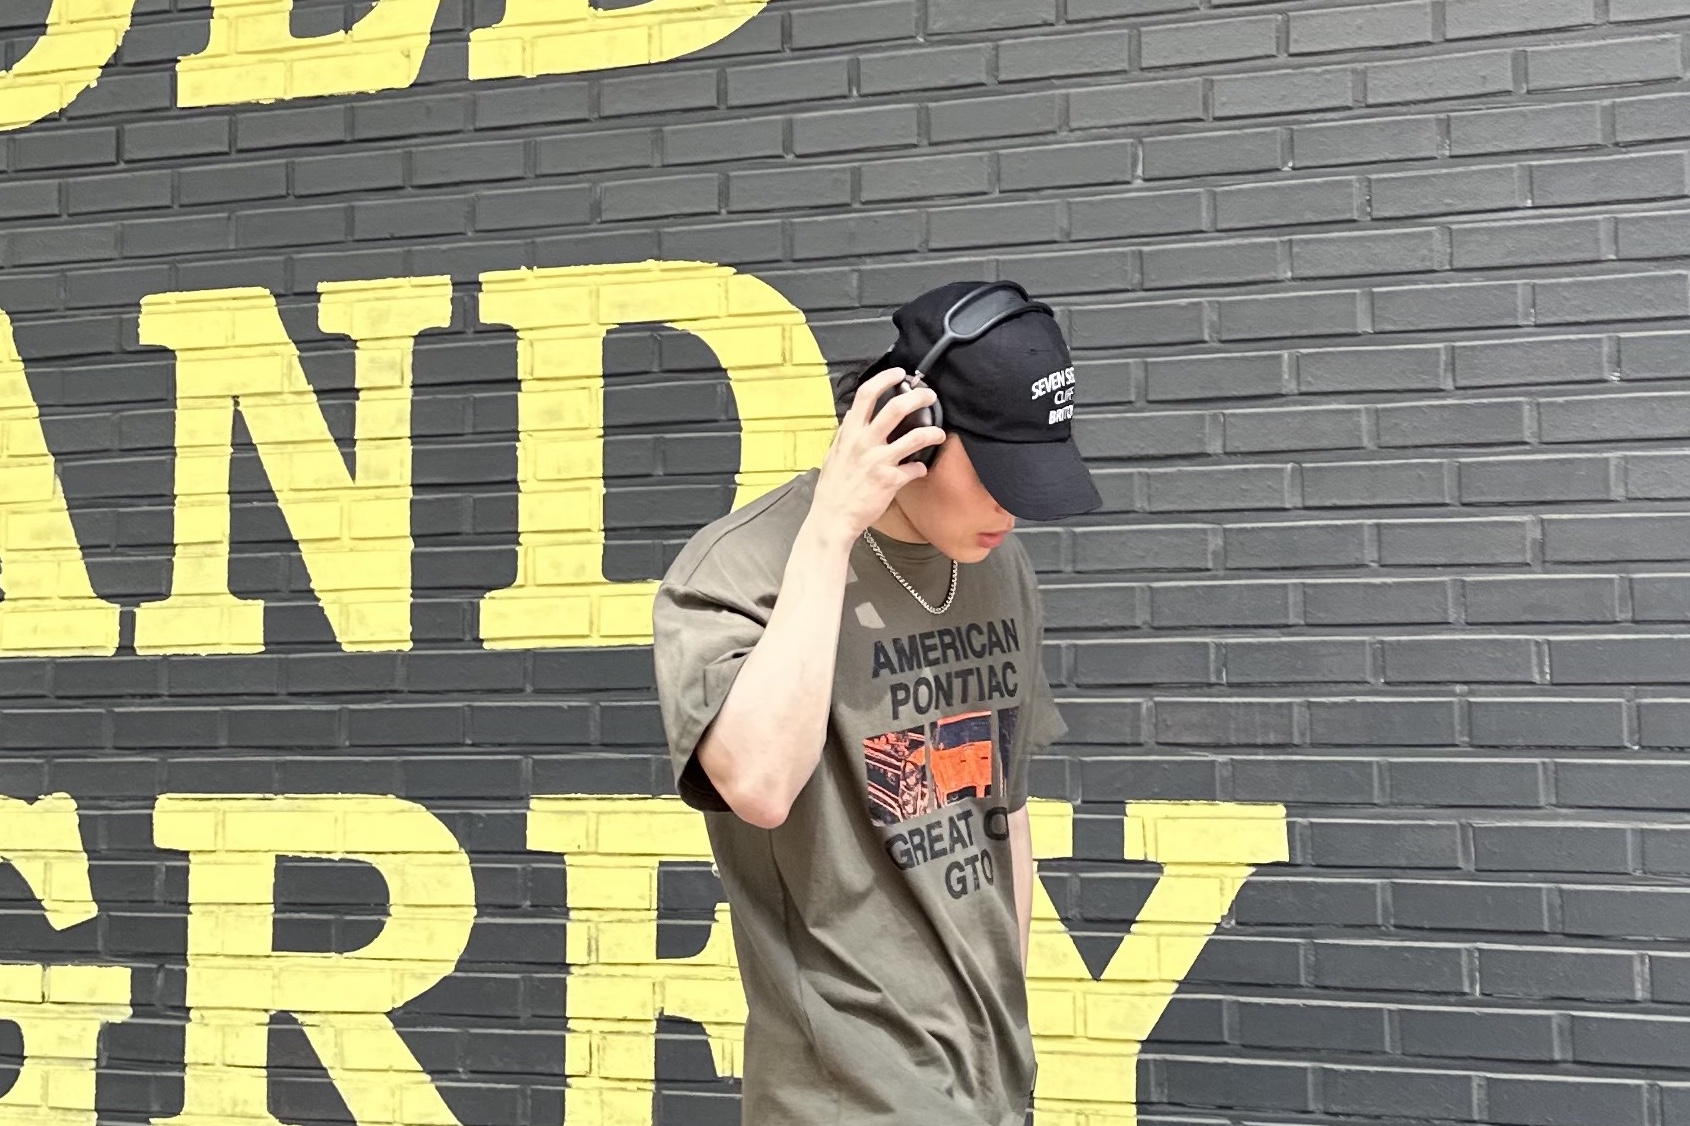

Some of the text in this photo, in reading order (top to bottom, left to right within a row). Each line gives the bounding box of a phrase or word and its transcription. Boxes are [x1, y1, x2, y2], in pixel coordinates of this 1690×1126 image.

[1031, 370, 1066, 400] SEVEN
[872, 618, 1020, 678] AMERICAN
[890, 661, 1018, 720] PONTIAC
[885, 809, 974, 870] GREAT
[945, 849, 994, 899] GTO
